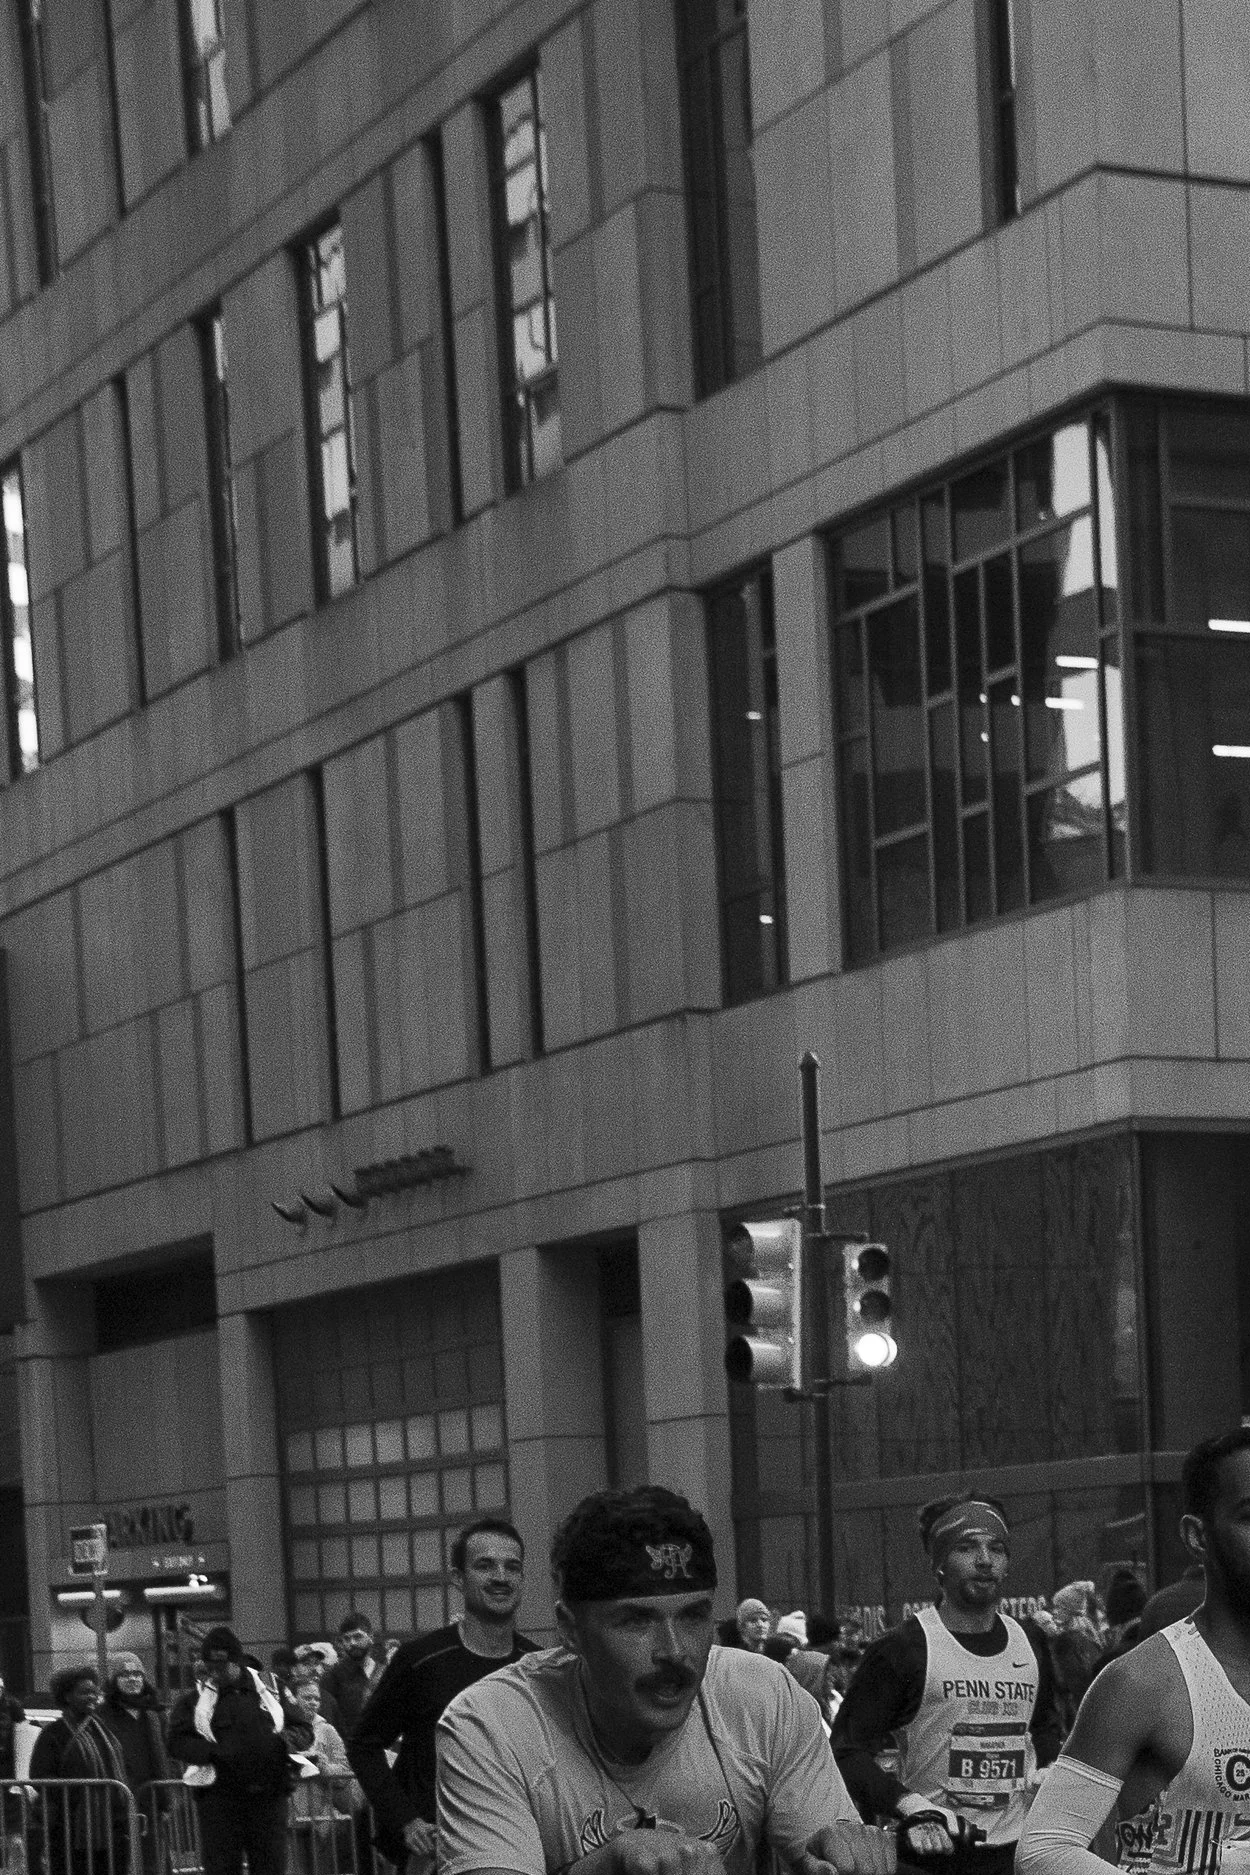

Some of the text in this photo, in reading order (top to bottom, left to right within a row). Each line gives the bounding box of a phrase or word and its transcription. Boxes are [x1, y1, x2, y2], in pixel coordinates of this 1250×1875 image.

[98, 1503, 195, 1550] ARKING
[943, 1680, 1034, 1703] PENN STATE
[961, 1758, 1017, 1779] B 9571
[1214, 1758, 1232, 1798] CHICAGO
